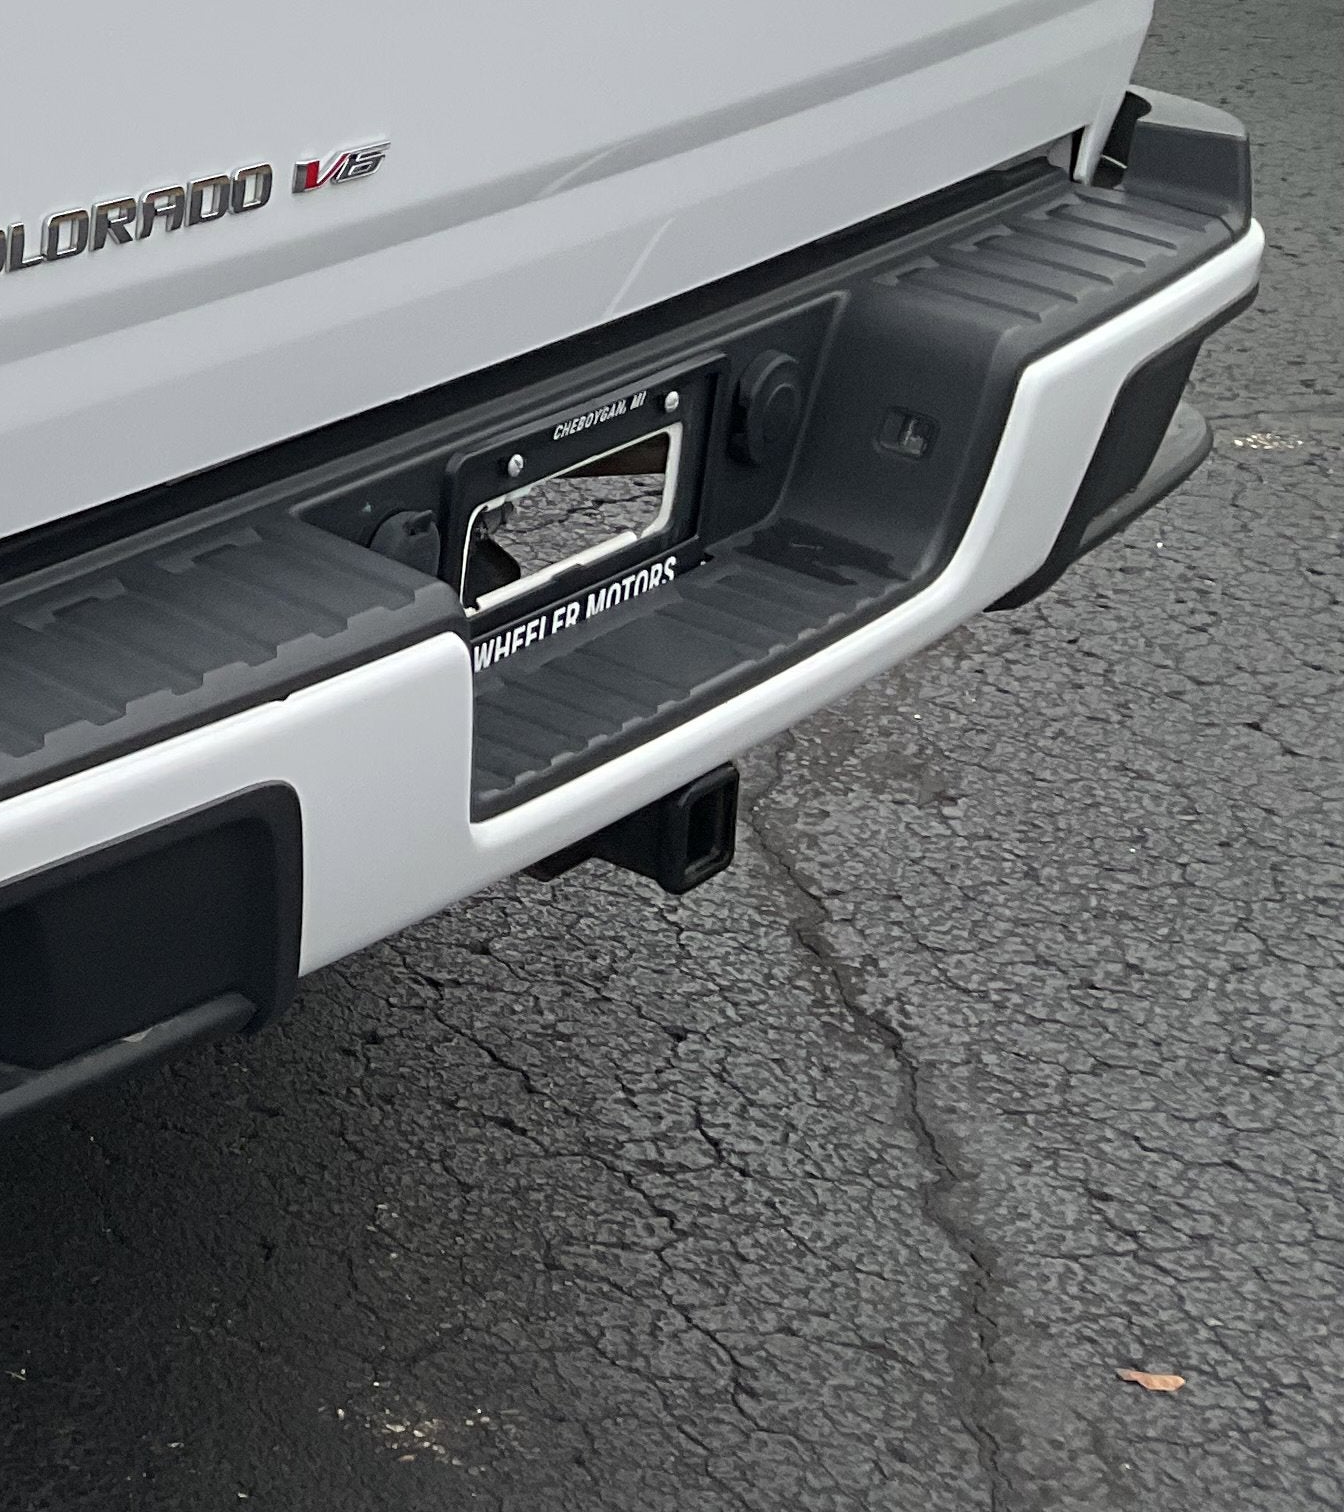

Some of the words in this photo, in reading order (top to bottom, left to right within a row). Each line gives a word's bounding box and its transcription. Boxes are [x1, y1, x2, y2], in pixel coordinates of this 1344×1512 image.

[291, 139, 391, 194] V6
[553, 399, 628, 441] CHEBOYGAN,
[629, 390, 647, 410] MI
